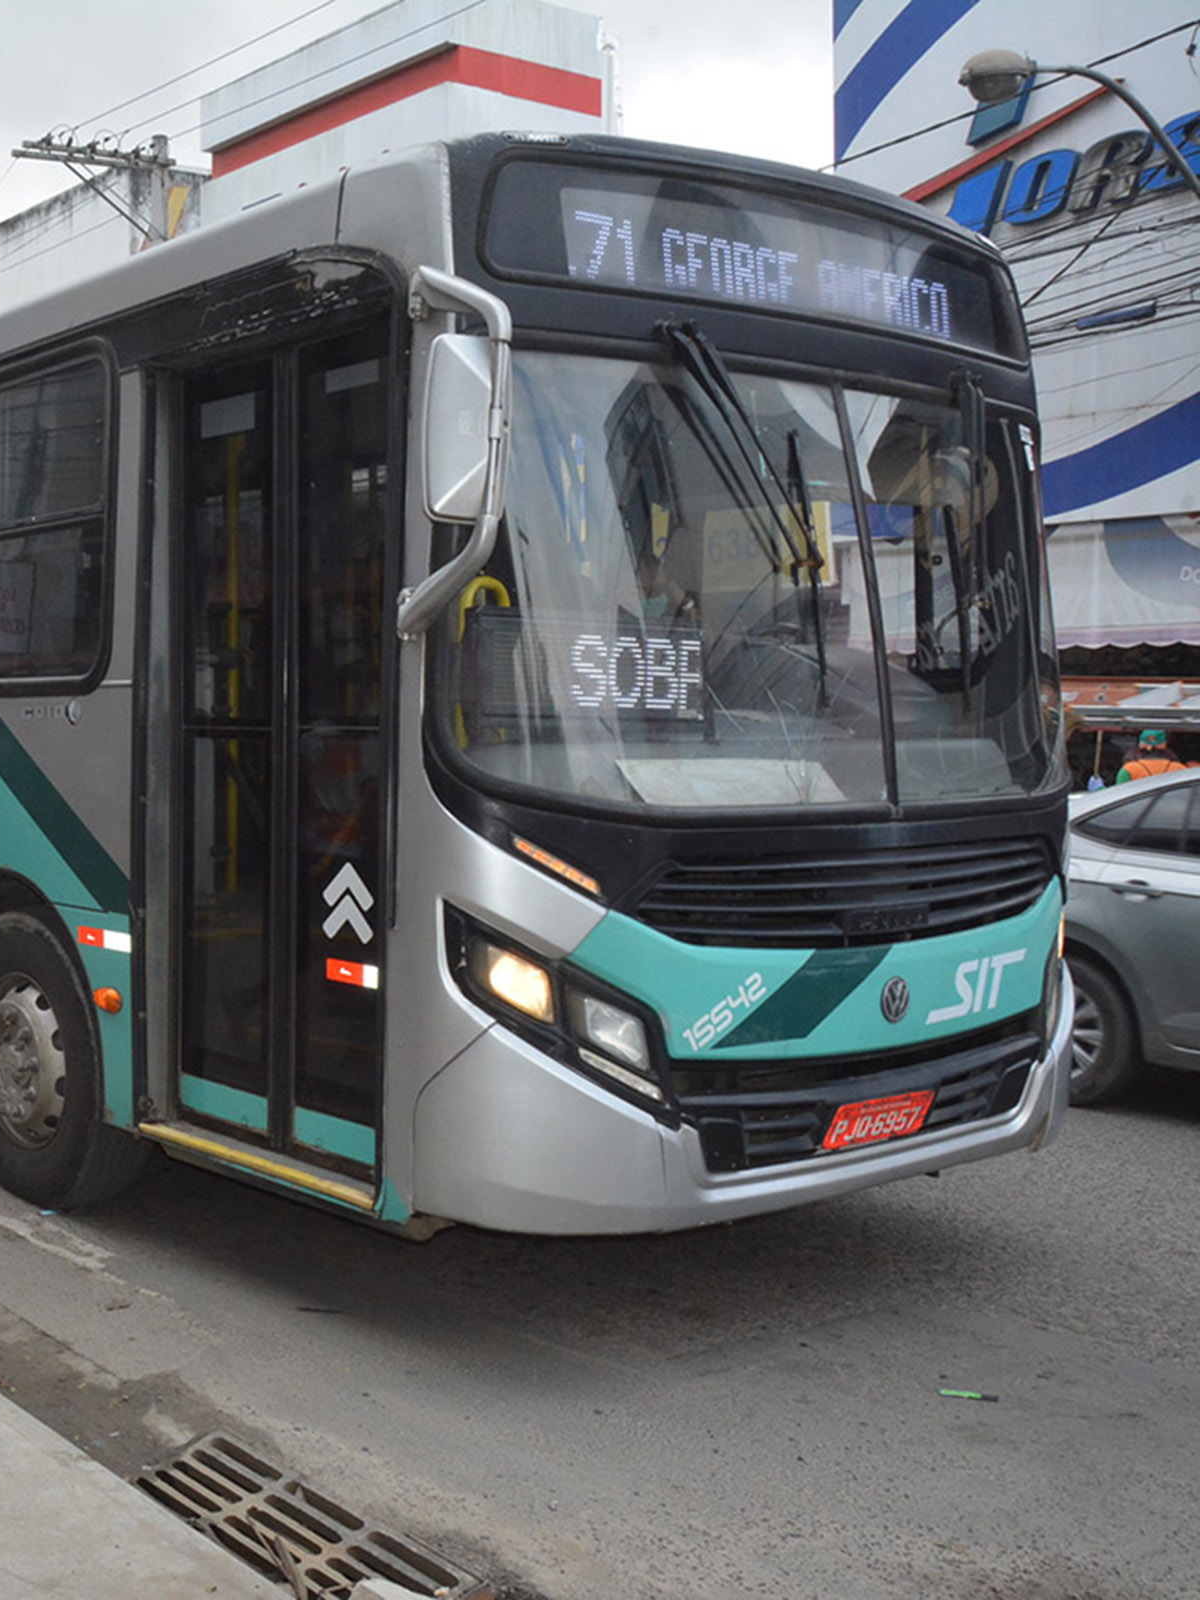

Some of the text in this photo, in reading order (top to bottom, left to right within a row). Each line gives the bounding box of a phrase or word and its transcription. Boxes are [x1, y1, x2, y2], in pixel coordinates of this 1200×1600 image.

[573, 209, 637, 285] 71
[681, 971, 768, 1053] 15542
[925, 948, 1028, 1026] SIT
